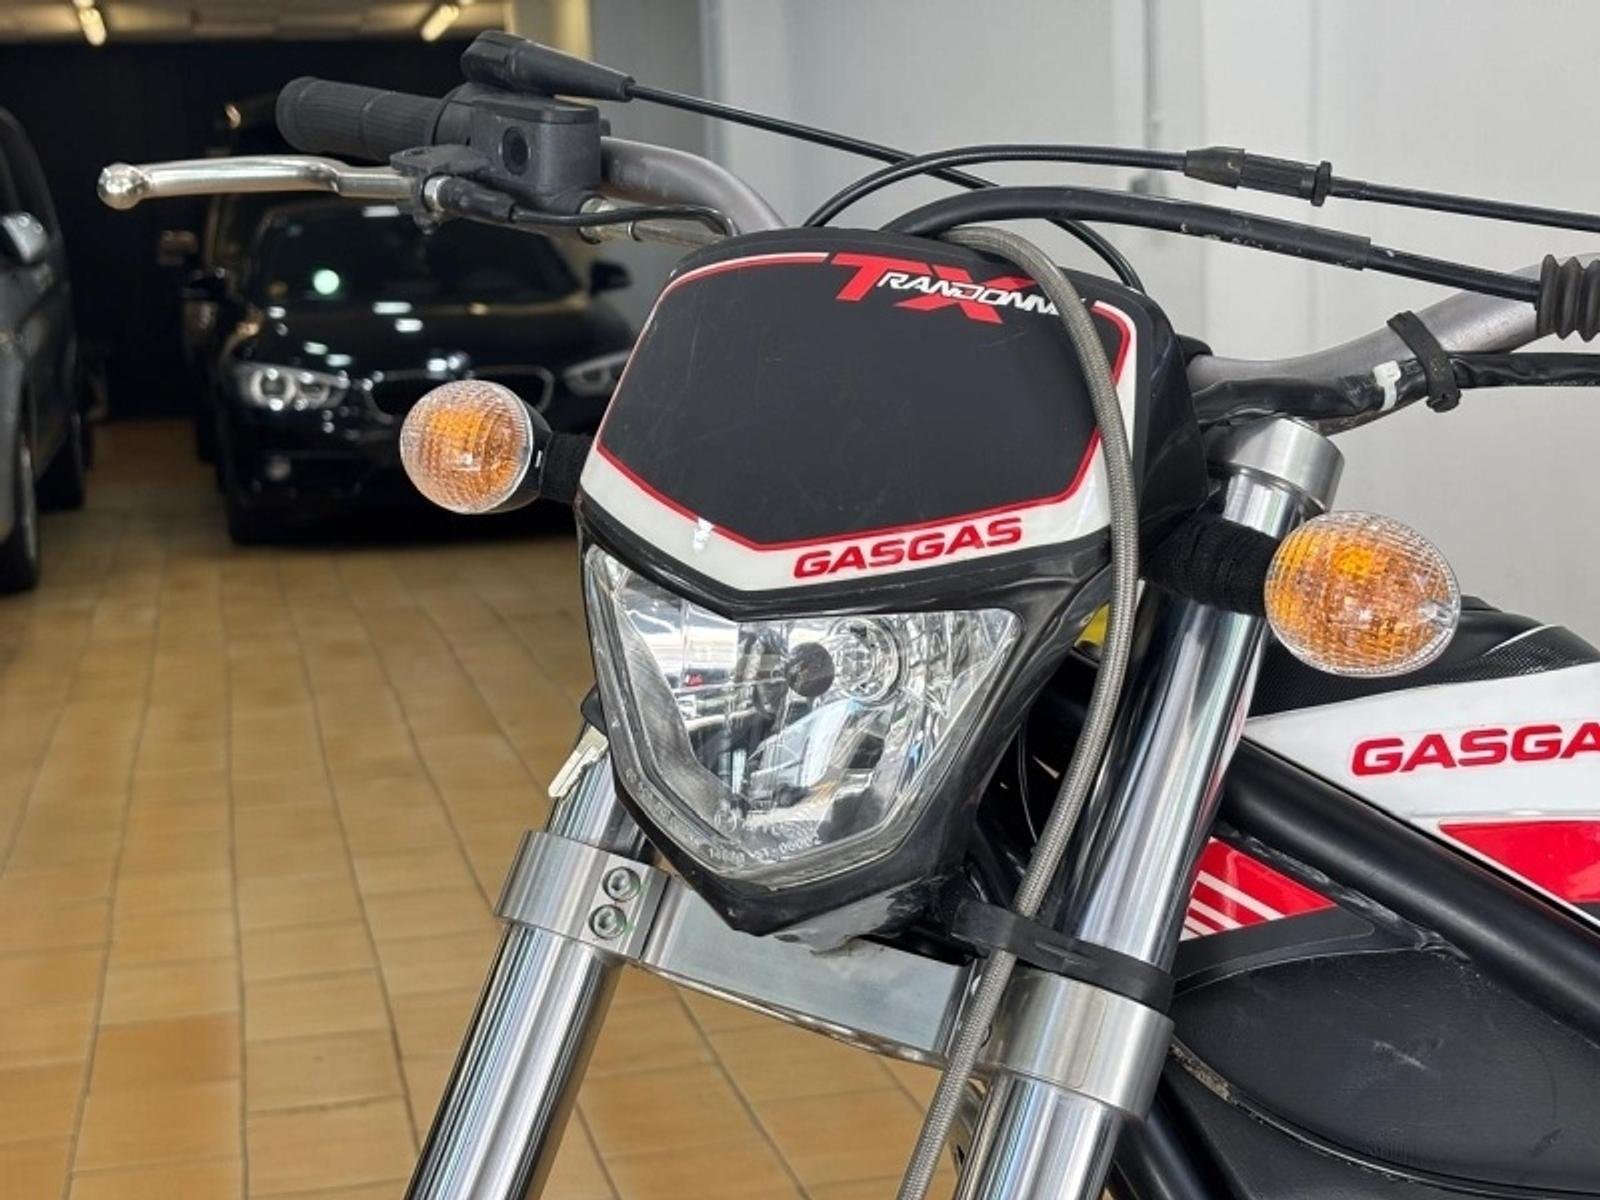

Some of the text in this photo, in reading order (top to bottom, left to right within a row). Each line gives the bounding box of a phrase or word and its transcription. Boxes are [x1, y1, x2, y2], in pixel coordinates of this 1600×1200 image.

[877, 271, 1087, 316] RANDONN
[793, 517, 1022, 579] GASGAS
[1351, 722, 1600, 776] GASGA
